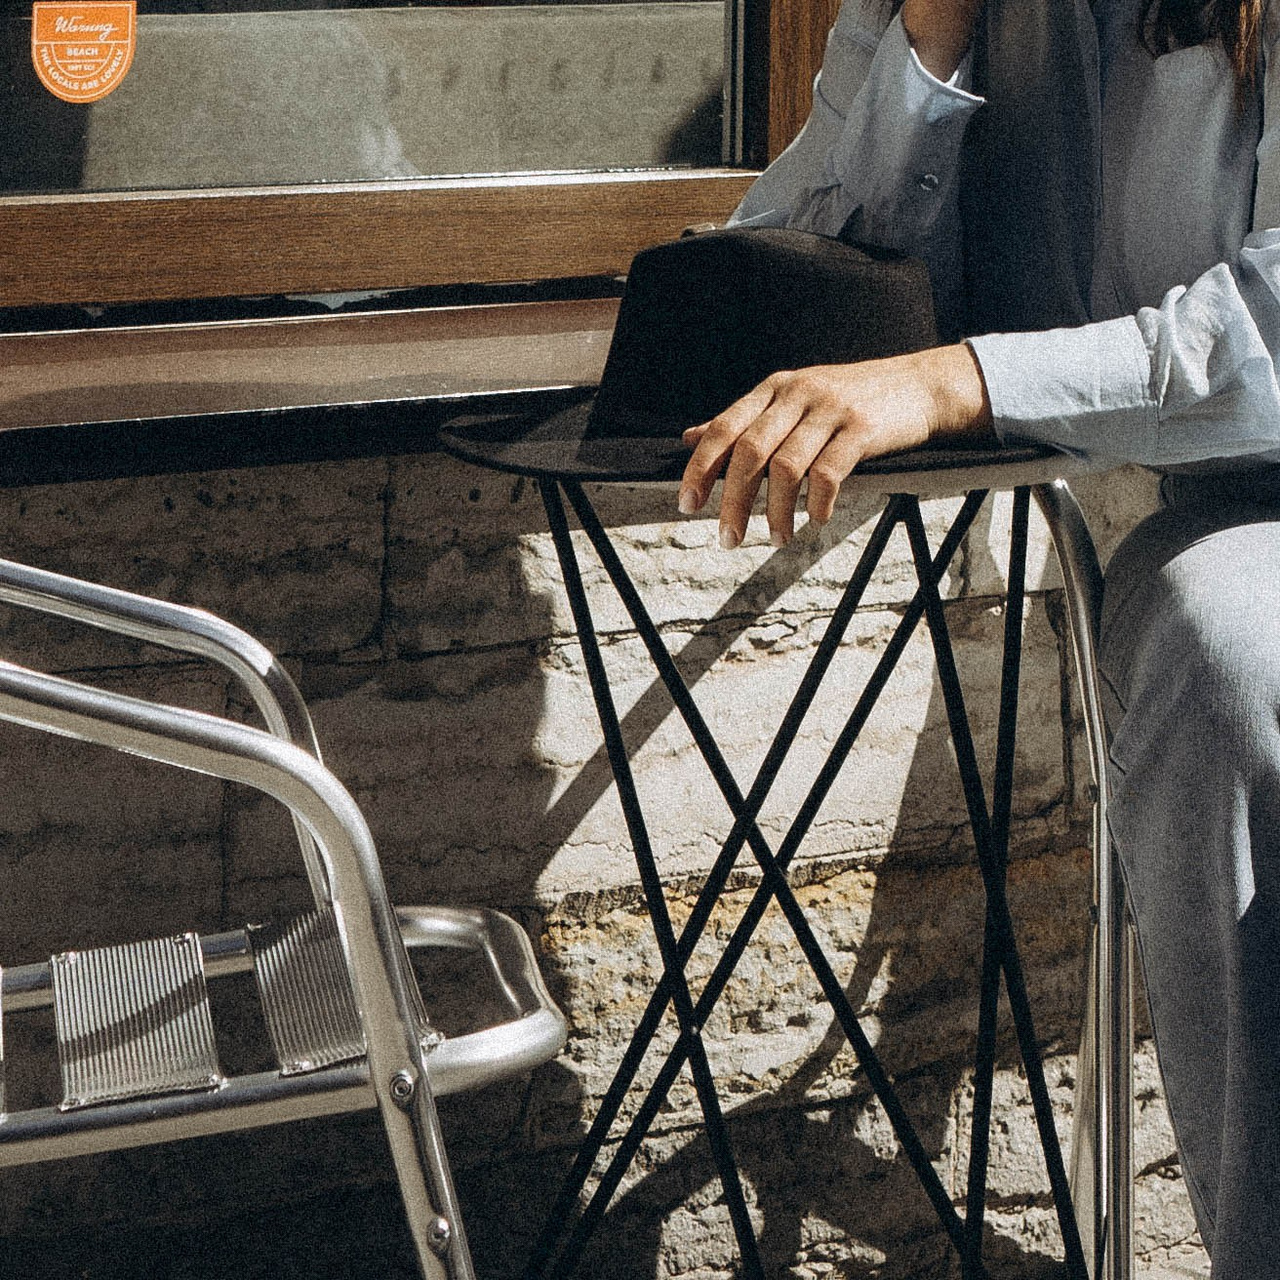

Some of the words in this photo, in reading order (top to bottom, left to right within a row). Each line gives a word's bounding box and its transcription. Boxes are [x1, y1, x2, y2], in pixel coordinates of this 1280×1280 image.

[66, 47, 98, 56] BEACH
[40, 46, 51, 68] THE
[47, 66, 79, 90] LOCALS
[81, 79, 99, 90] ARE
